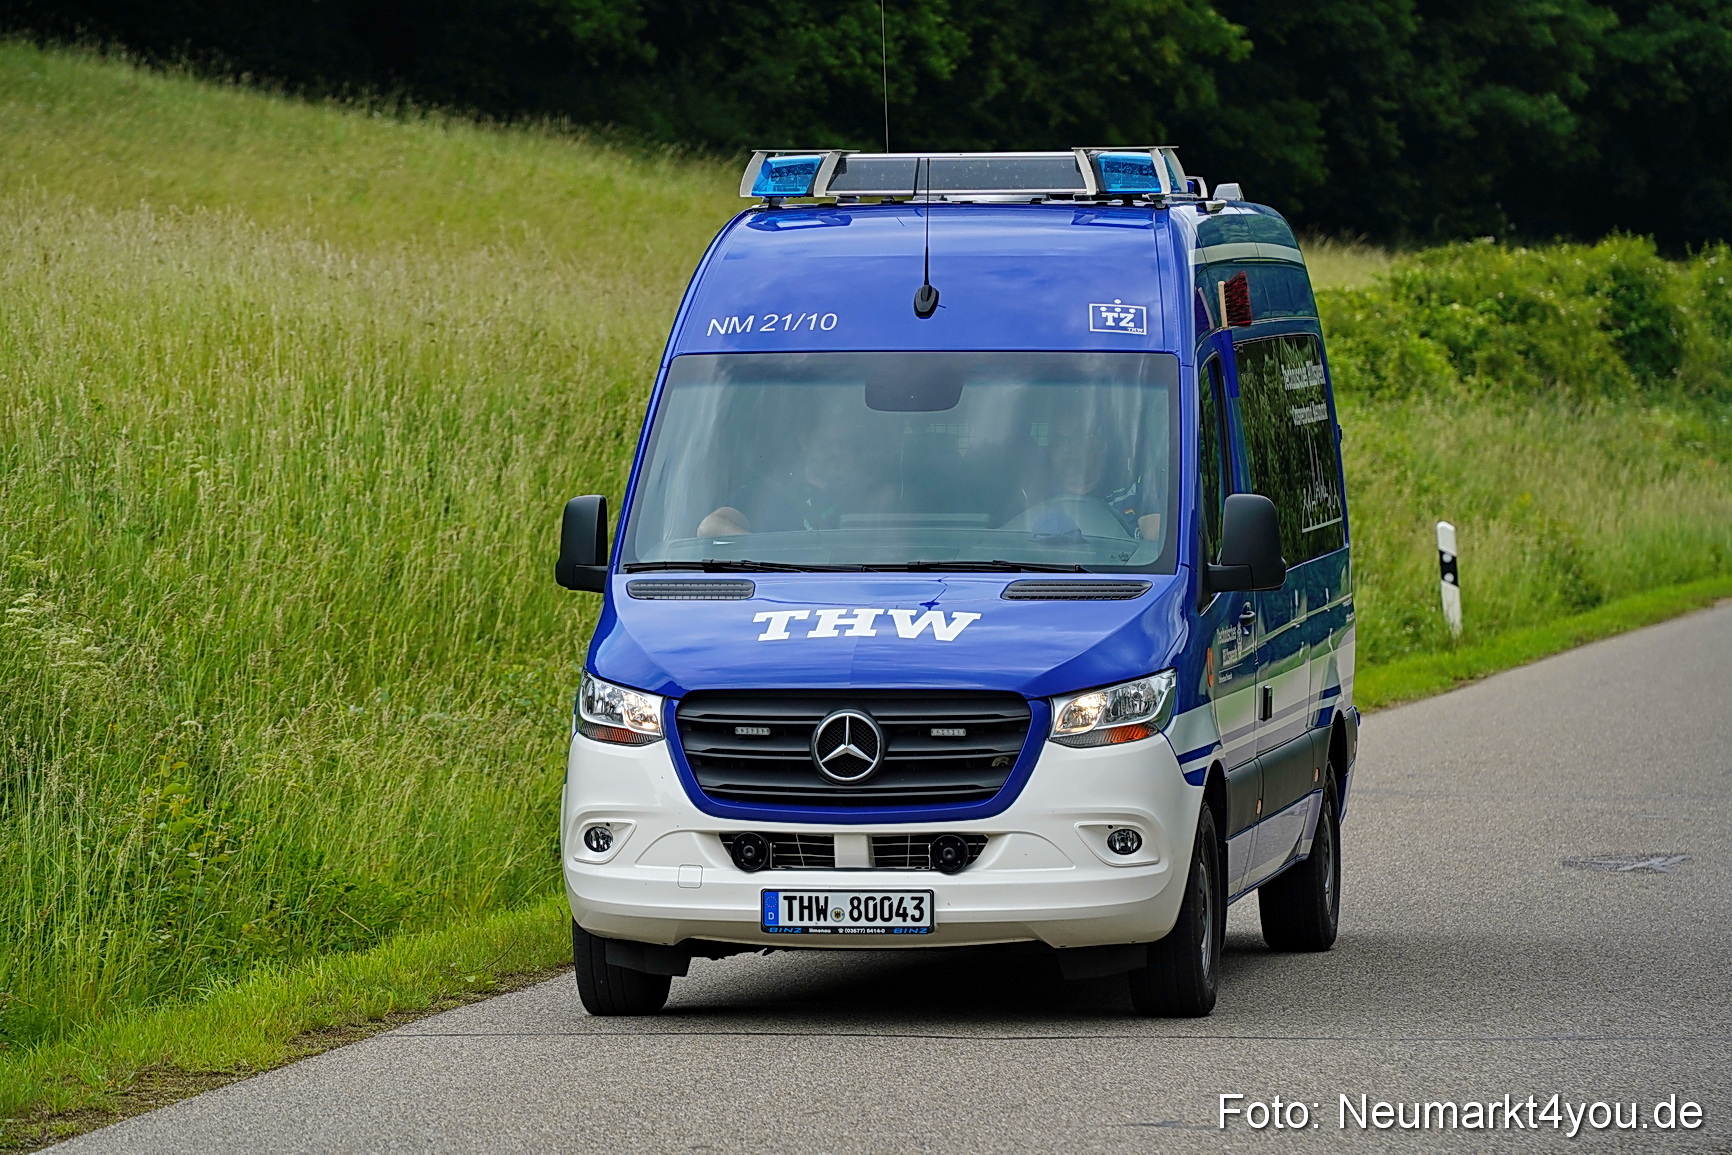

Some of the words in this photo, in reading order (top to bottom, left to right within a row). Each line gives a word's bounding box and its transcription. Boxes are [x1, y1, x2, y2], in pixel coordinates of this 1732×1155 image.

[706, 315, 755, 337] NM
[759, 312, 838, 332] 21/10
[1101, 312, 1135, 328] TZ
[752, 608, 982, 642] THW
[768, 911, 775, 920] D
[783, 896, 829, 922] THW
[849, 896, 925, 923] 80043
